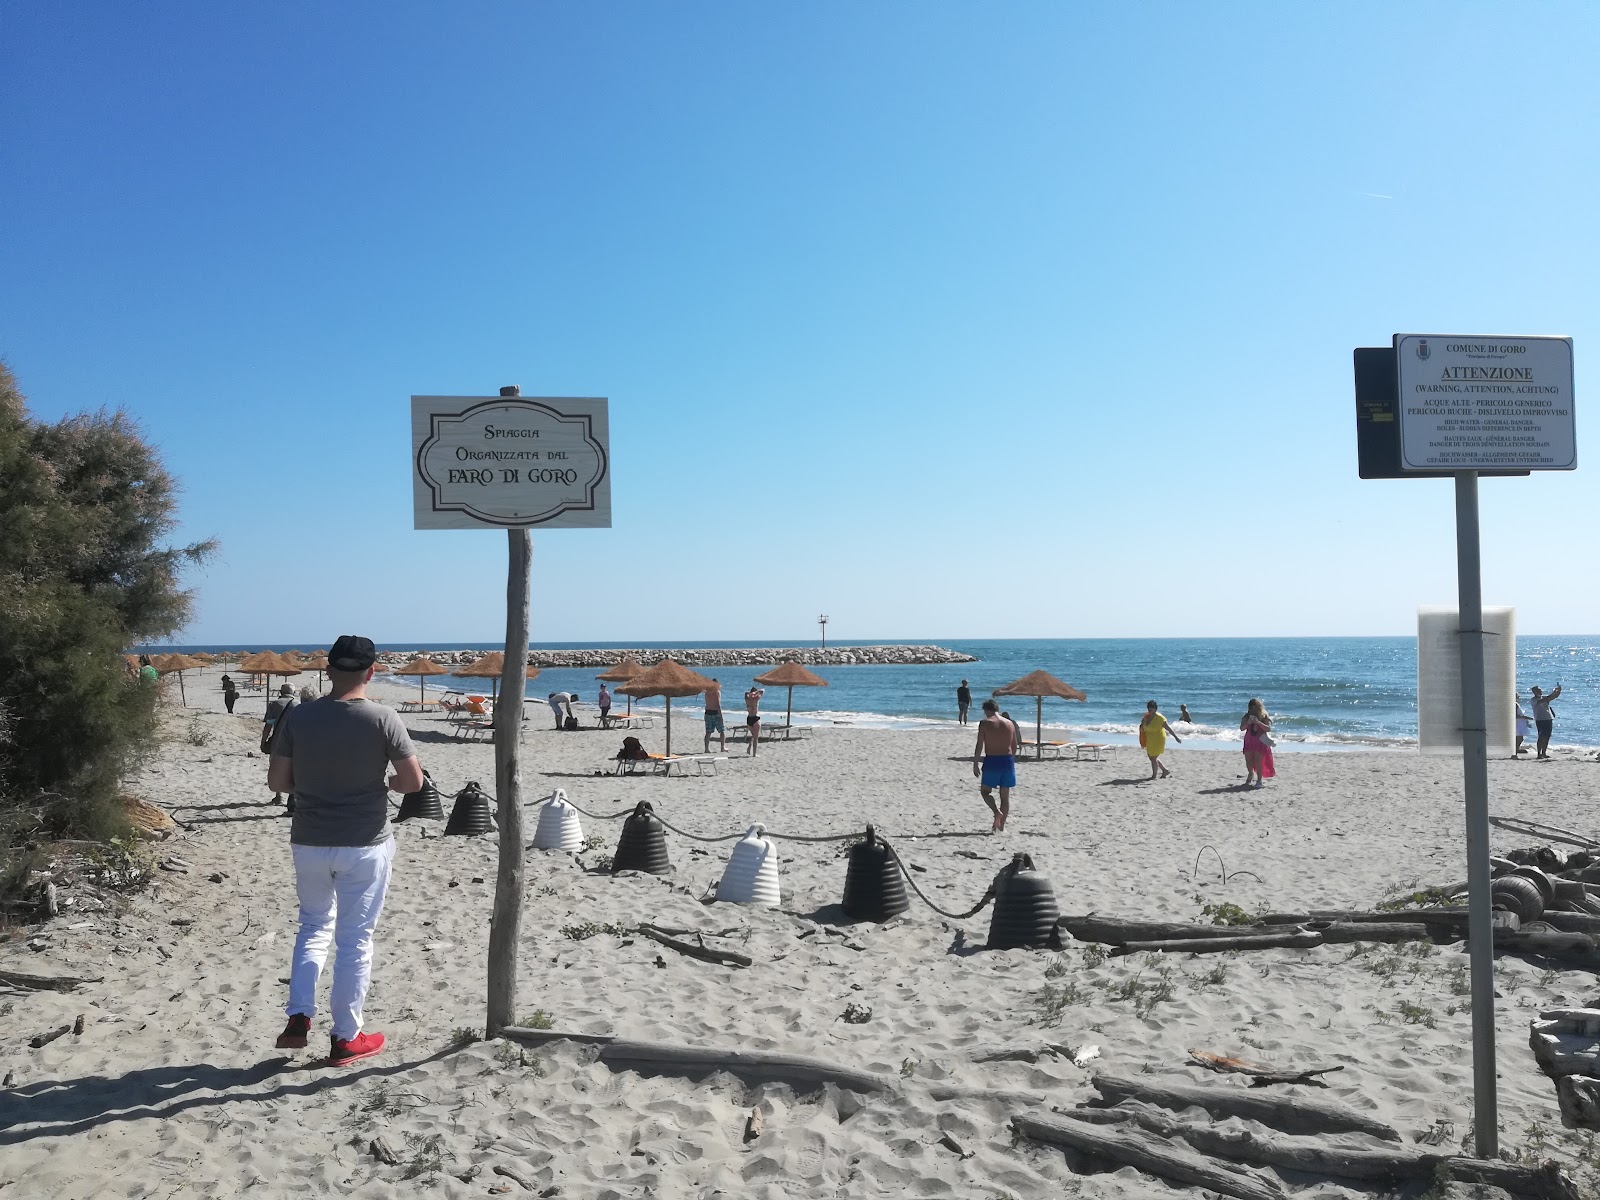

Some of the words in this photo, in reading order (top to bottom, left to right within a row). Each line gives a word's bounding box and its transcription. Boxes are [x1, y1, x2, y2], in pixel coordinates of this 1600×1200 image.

[1446, 345, 1486, 353] COMUNE
[1441, 367, 1533, 379] ATTENZIONE
[1416, 385, 1462, 393] (WARNING,
[448, 469, 493, 486] FARO
[499, 469, 519, 483] DI
[528, 468, 577, 486] GORO
